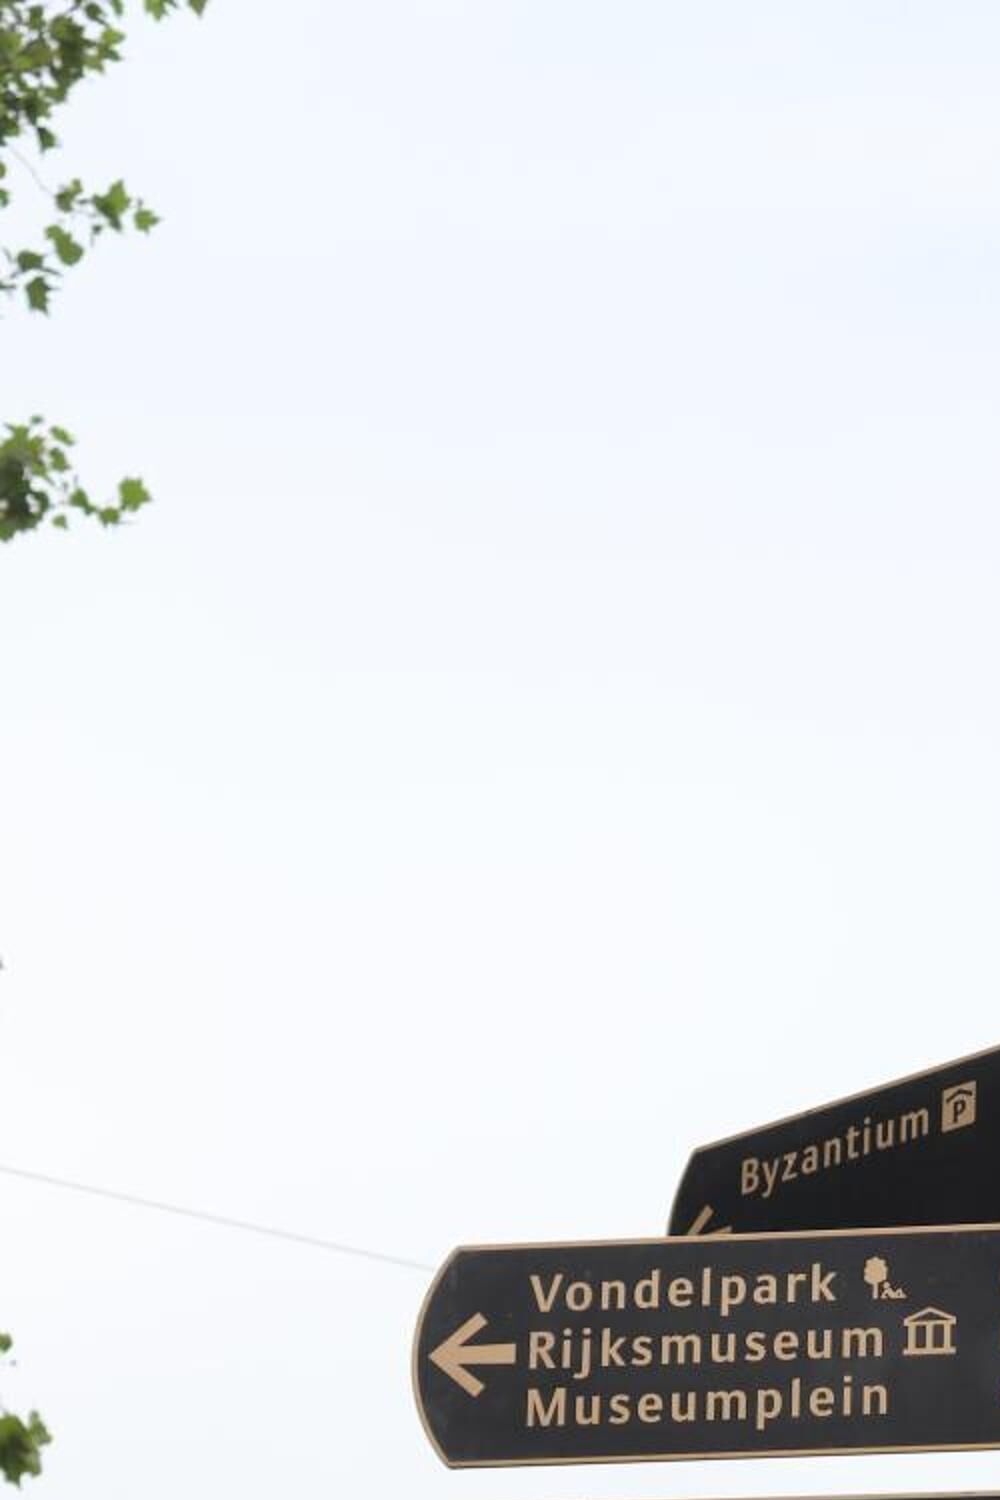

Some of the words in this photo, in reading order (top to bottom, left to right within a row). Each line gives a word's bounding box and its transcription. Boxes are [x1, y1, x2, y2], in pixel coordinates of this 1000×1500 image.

[741, 1106, 930, 1198] Byzantium
[529, 1263, 837, 1316] Vondelpark
[528, 1326, 883, 1380] Rijksmuseum
[526, 1376, 888, 1430] Museumplein
